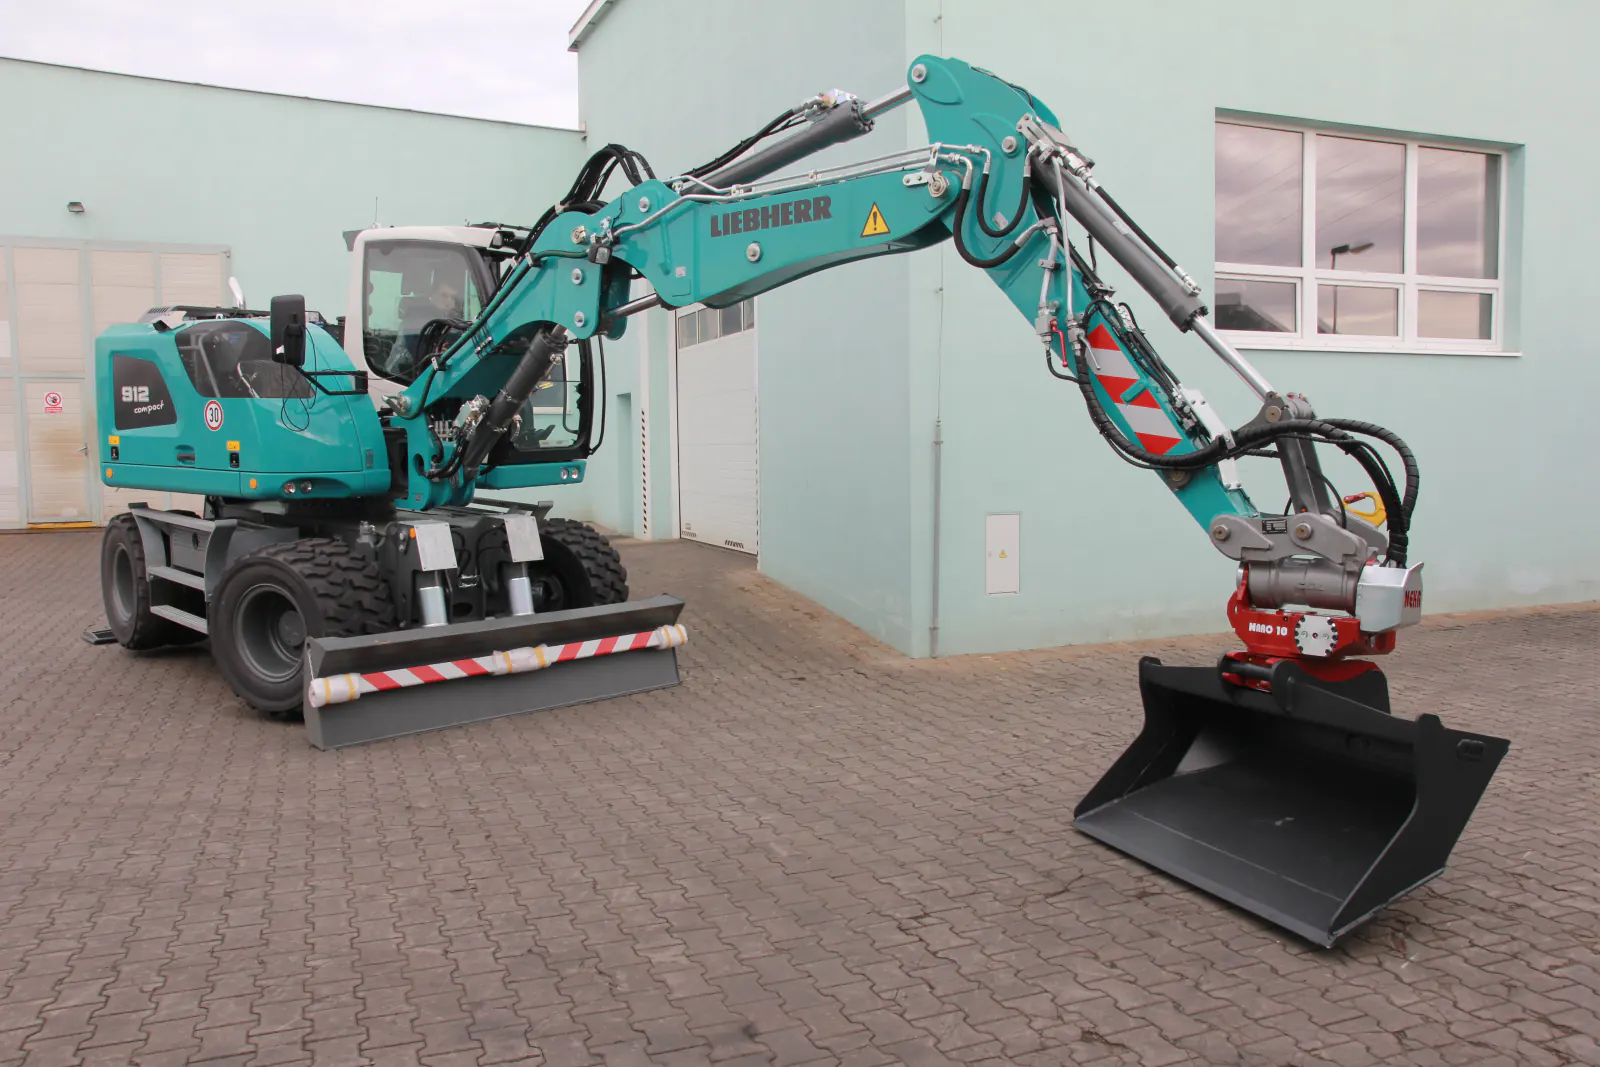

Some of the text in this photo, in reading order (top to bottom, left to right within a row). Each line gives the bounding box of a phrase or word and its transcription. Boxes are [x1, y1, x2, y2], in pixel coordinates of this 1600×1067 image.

[711, 195, 832, 238] LIEBHERR
[122, 386, 149, 402] 912
[134, 400, 164, 414] compact
[209, 407, 219, 423] 30
[1276, 626, 1288, 636] 10
